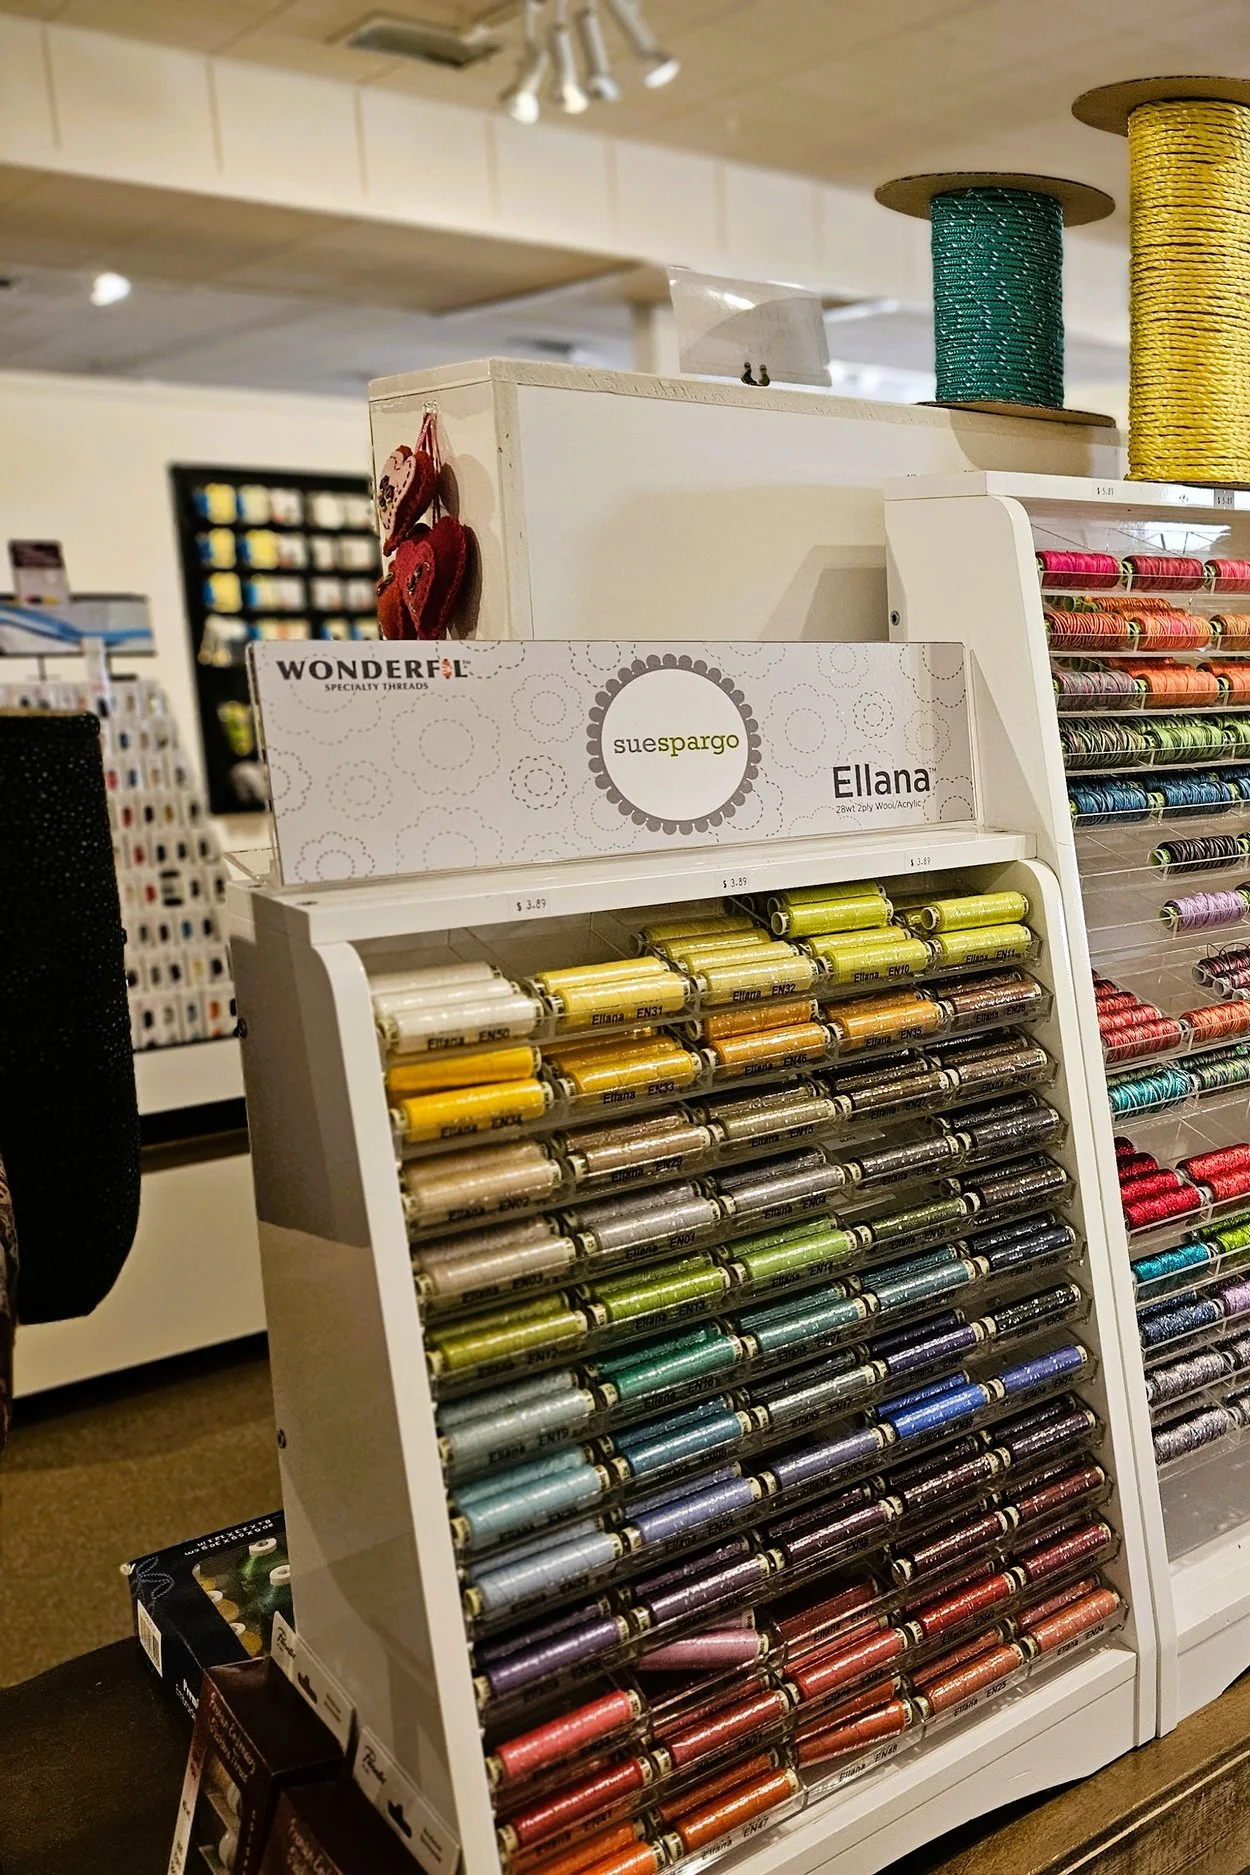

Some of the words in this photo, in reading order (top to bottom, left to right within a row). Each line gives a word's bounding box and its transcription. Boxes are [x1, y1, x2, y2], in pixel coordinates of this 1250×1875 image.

[325, 682, 381, 692] SPECIALTY
[383, 682, 429, 692] THREADS
[613, 731, 741, 758] suespargo
[835, 804, 855, 815] 28wt
[857, 802, 873, 814] 2ply
[875, 799, 923, 813] Wool/Acrylic
[917, 856, 931, 867] 3.89
[722, 878, 727, 889] $
[730, 875, 748, 888] 3.89
[966, 953, 989, 965] Ellana
[996, 949, 1016, 959] EN11
[854, 970, 879, 983] Ellana
[888, 964, 910, 976] EN10
[733, 988, 761, 1001] Ellana
[772, 983, 796, 996] EN32
[592, 1012, 625, 1026] Ellana
[636, 1006, 663, 1019] EN31
[428, 1036, 464, 1050] Ellana
[866, 1034, 891, 1047] Ellana
[900, 1027, 922, 1040] EN35
[744, 1062, 773, 1076] Ellana
[603, 1090, 636, 1104] Ellana
[648, 1082, 675, 1095] EN33
[751, 1134, 780, 1148] Ellana
[612, 1168, 644, 1182] Ellana
[764, 1205, 793, 1219] Ellana
[802, 1195, 827, 1209] EN04
[626, 1244, 658, 1259] Ellana
[669, 1234, 696, 1248] EN01
[772, 1274, 801, 1288] Ellana
[635, 1314, 667, 1329] Ellana
[184, 1548, 200, 1556] cm
[814, 1624, 842, 1641] Ellana
[953, 1698, 978, 1717] Ellana
[986, 1681, 1007, 1698] EN25
[839, 1763, 866, 1782] Ellana
[875, 1744, 898, 1762] EN48
[743, 1817, 770, 1837] EN47
